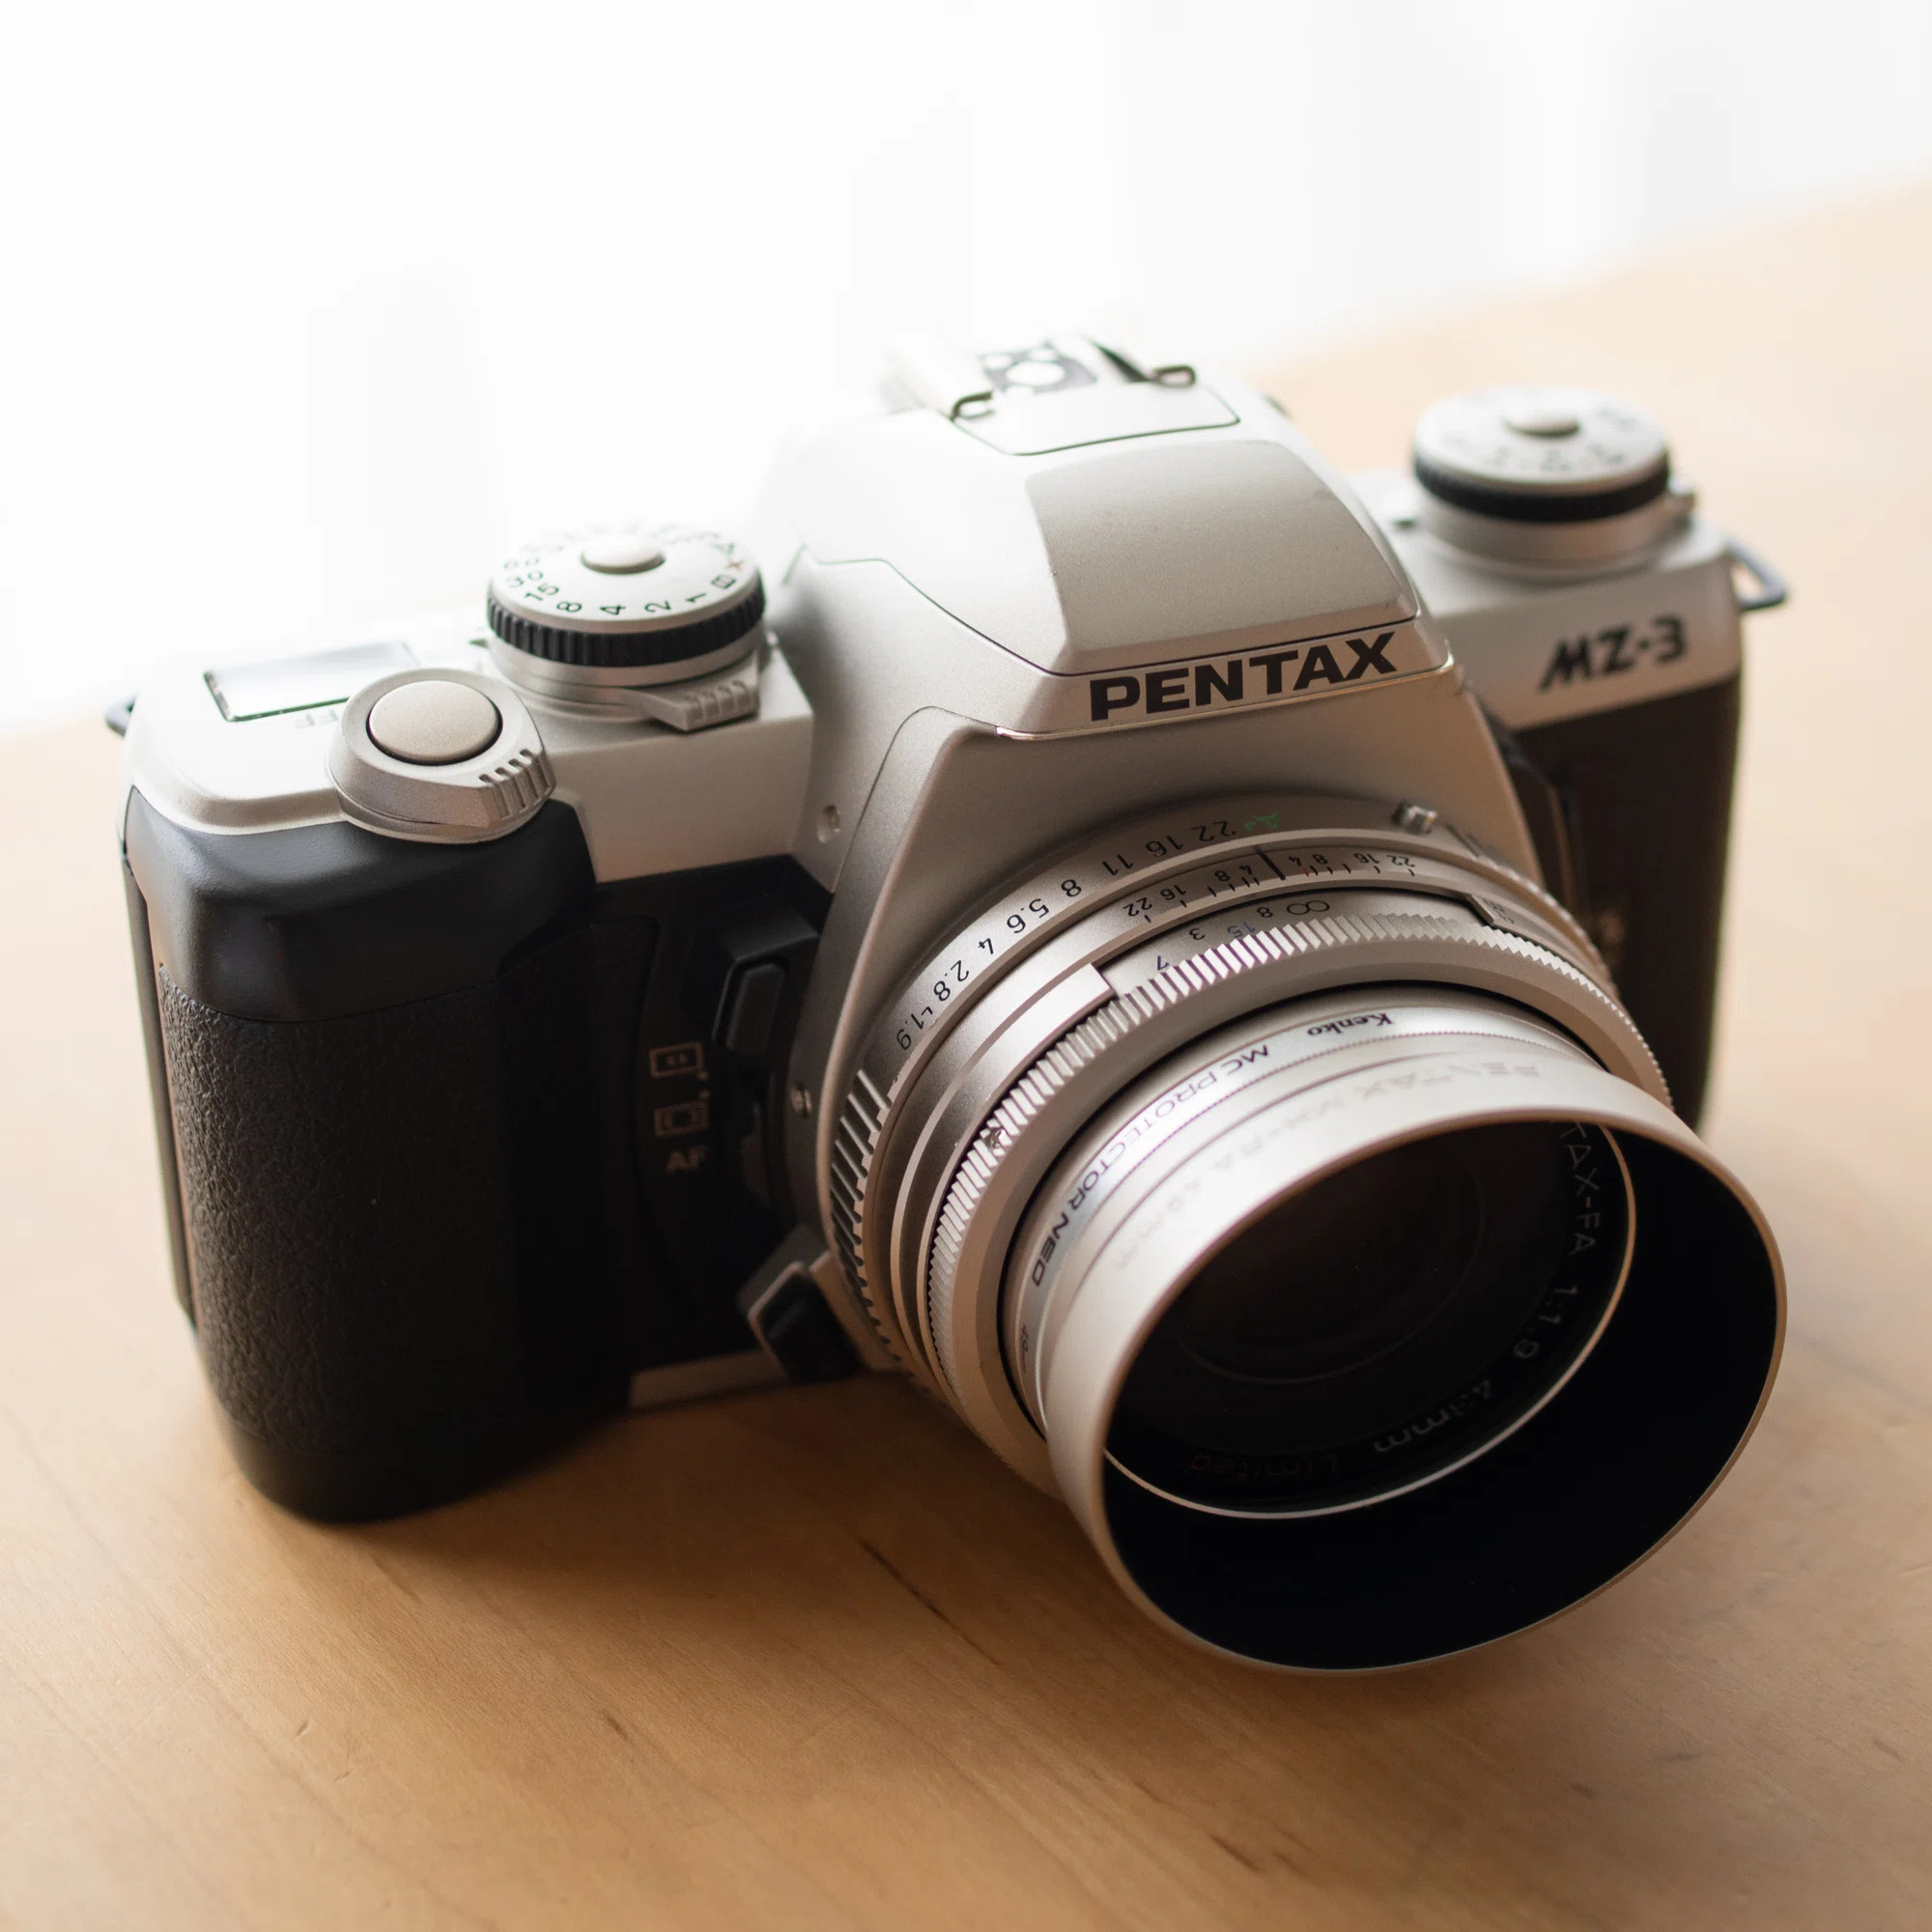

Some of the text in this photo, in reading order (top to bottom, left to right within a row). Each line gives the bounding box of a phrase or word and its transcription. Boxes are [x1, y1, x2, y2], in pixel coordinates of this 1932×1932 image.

[525, 582, 559, 601] 15
[555, 601, 582, 613] 8
[599, 605, 627, 616] 4
[644, 600, 671, 613] 2
[1540, 615, 1689, 694] MZ-3
[1089, 631, 1398, 722] PENTAX
[1189, 819, 1236, 842] 22
[1145, 835, 1184, 858] 16
[1100, 853, 1135, 877] 11
[1060, 877, 1083, 898] 8
[1122, 852, 1416, 918] 22 16 8 4 4 8 16 22
[1006, 897, 1050, 934] 5.6
[1257, 906, 1274, 919] 8
[1188, 926, 1206, 941] 3
[1227, 921, 1256, 938] 15
[978, 936, 995, 955] 4
[1156, 955, 1170, 972] 7
[932, 959, 970, 1003] 2.8
[1306, 1012, 1395, 1037] Kenko
[1220, 1044, 1269, 1075] MC
[1353, 1061, 1540, 1103] PENTAX
[1066, 1070, 1217, 1211] PROTECTOR
[666, 1146, 707, 1175] AF
[1558, 1121, 1603, 1256] TAX-FA
[1513, 1284, 1579, 1359] 1:1.9
